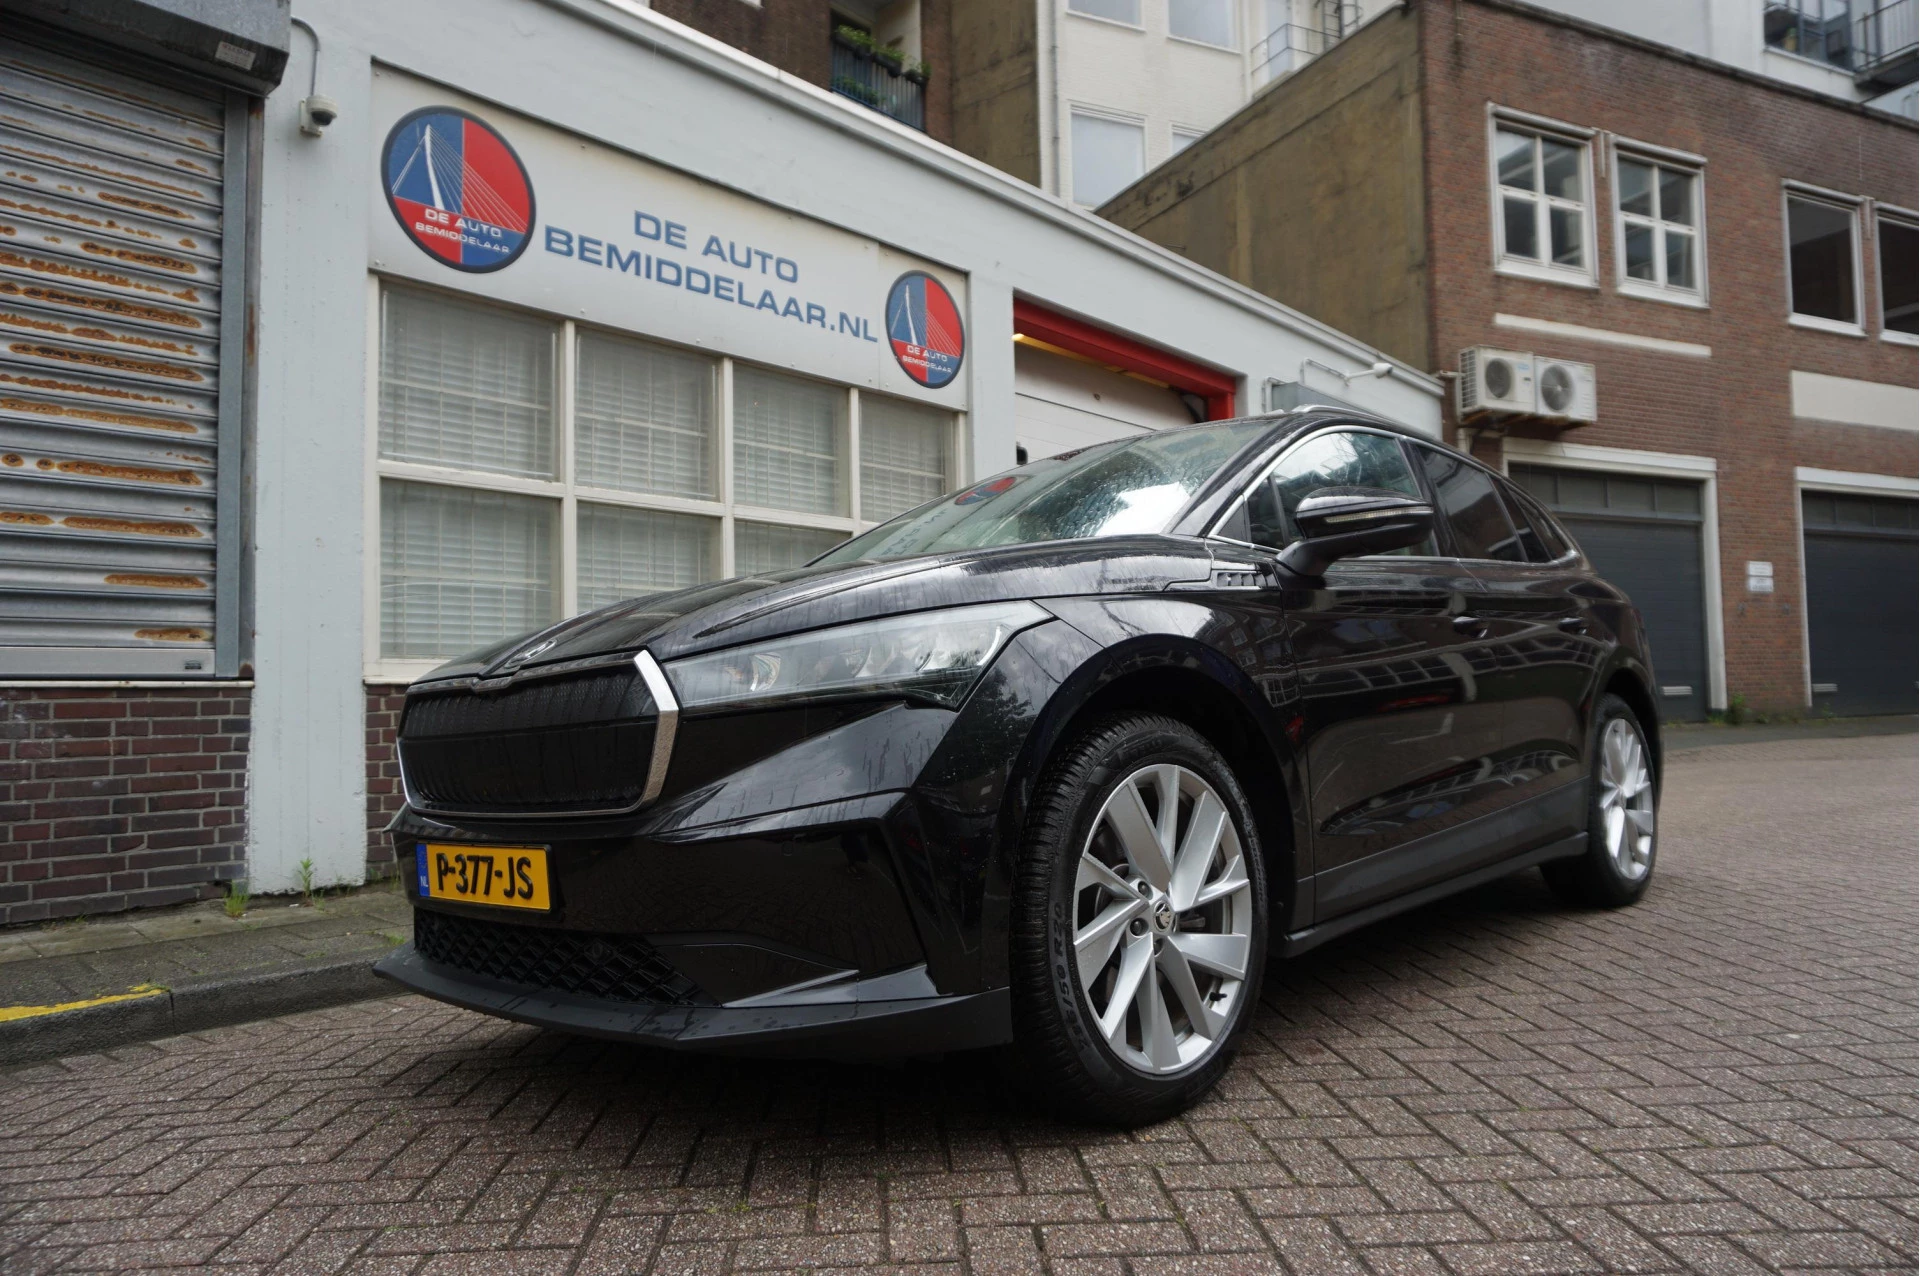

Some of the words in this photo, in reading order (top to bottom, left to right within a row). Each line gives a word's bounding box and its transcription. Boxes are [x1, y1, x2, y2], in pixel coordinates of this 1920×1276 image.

[415, 221, 510, 254] BEMIDDELAAR
[425, 208, 449, 224] DE
[455, 217, 502, 238] AUTO
[634, 210, 687, 249] DE
[702, 235, 798, 284] AUTO
[544, 224, 879, 343] BEMIDDELAAR.NL
[902, 355, 953, 374] BEMIDDELAAR
[907, 344, 921, 355] DE
[923, 349, 948, 362] AUTO
[420, 875, 429, 888] NL
[436, 852, 534, 900] P-377-JS
[1053, 902, 1064, 957] R20
